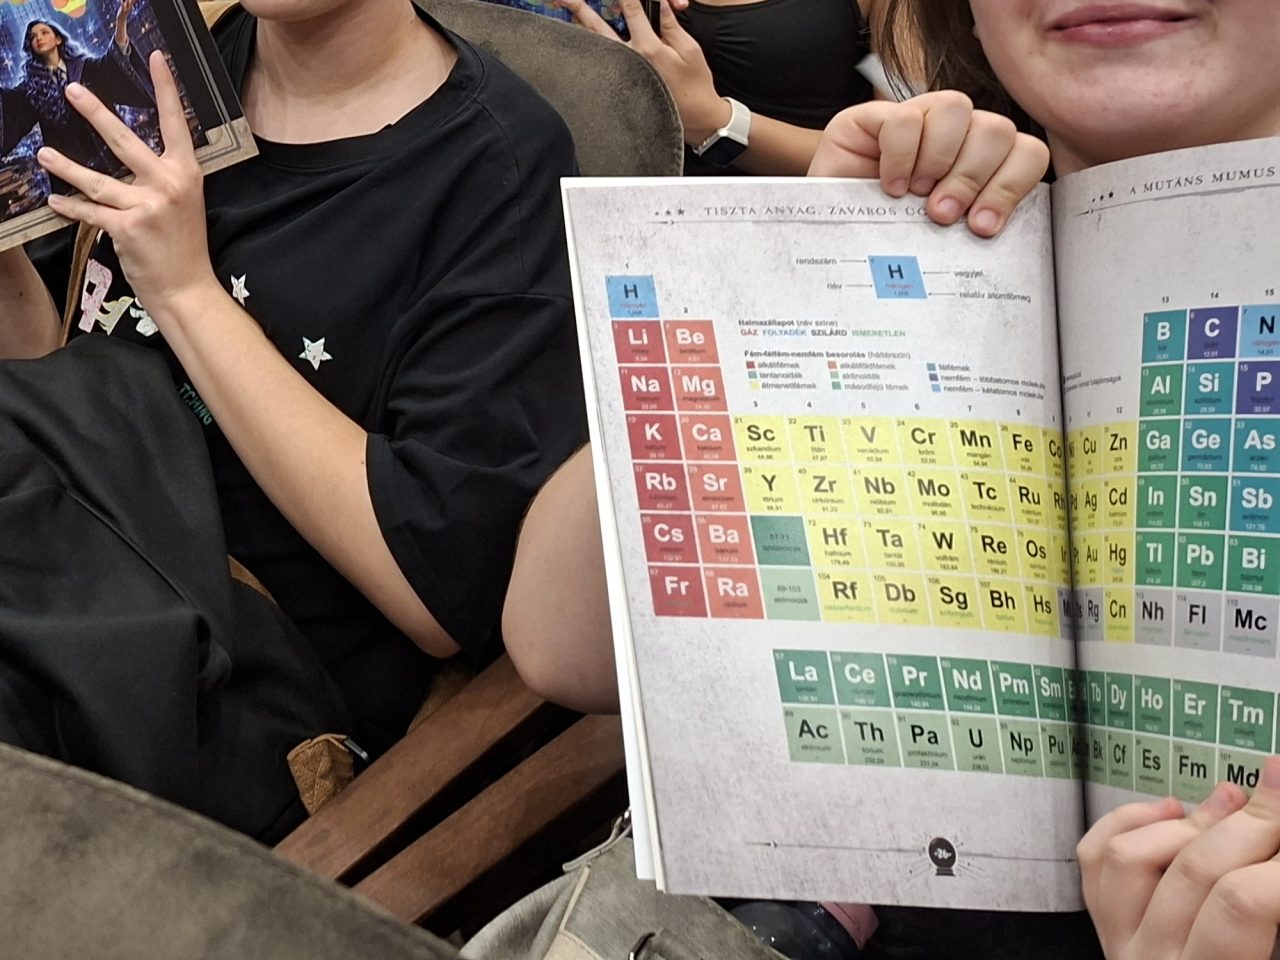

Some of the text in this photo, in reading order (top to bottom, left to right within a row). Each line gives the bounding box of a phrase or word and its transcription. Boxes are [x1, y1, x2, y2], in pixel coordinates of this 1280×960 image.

[1129, 166, 1275, 195] A MUTÁNS MUMUS
[703, 207, 757, 216] TISZTA
[829, 206, 897, 216] ZAVAROS
[888, 264, 904, 280] H
[624, 284, 638, 299] H
[628, 328, 705, 345] Li Be
[811, 329, 847, 337] SZILÁRD
[1157, 315, 1275, 340] B C N
[631, 375, 716, 396] Na Mg
[1151, 372, 1272, 395] Al Si P
[645, 423, 1275, 459] K Ca Sc Ti V Cr Mn Fe Co Cu Zn Ga Ge As
[645, 473, 1272, 511] Rb Sr Y Zr Nb Mo Tc Ru Ag Cd In Sn Sb
[654, 523, 1266, 570] Cs Ba Hf Ta W Re Os Au Hg Tl Pb Bi
[664, 576, 1267, 631] Fr Ra Rf Db Sg Bh Hs Rg Cn Nh Fl Mc
[788, 660, 1264, 725] La Ce Pr Nd Pm Sm Tb Dy Ho Er Tm
[798, 719, 1259, 788] Ac Th Pa U Np Pu Cf Es Fm Md
